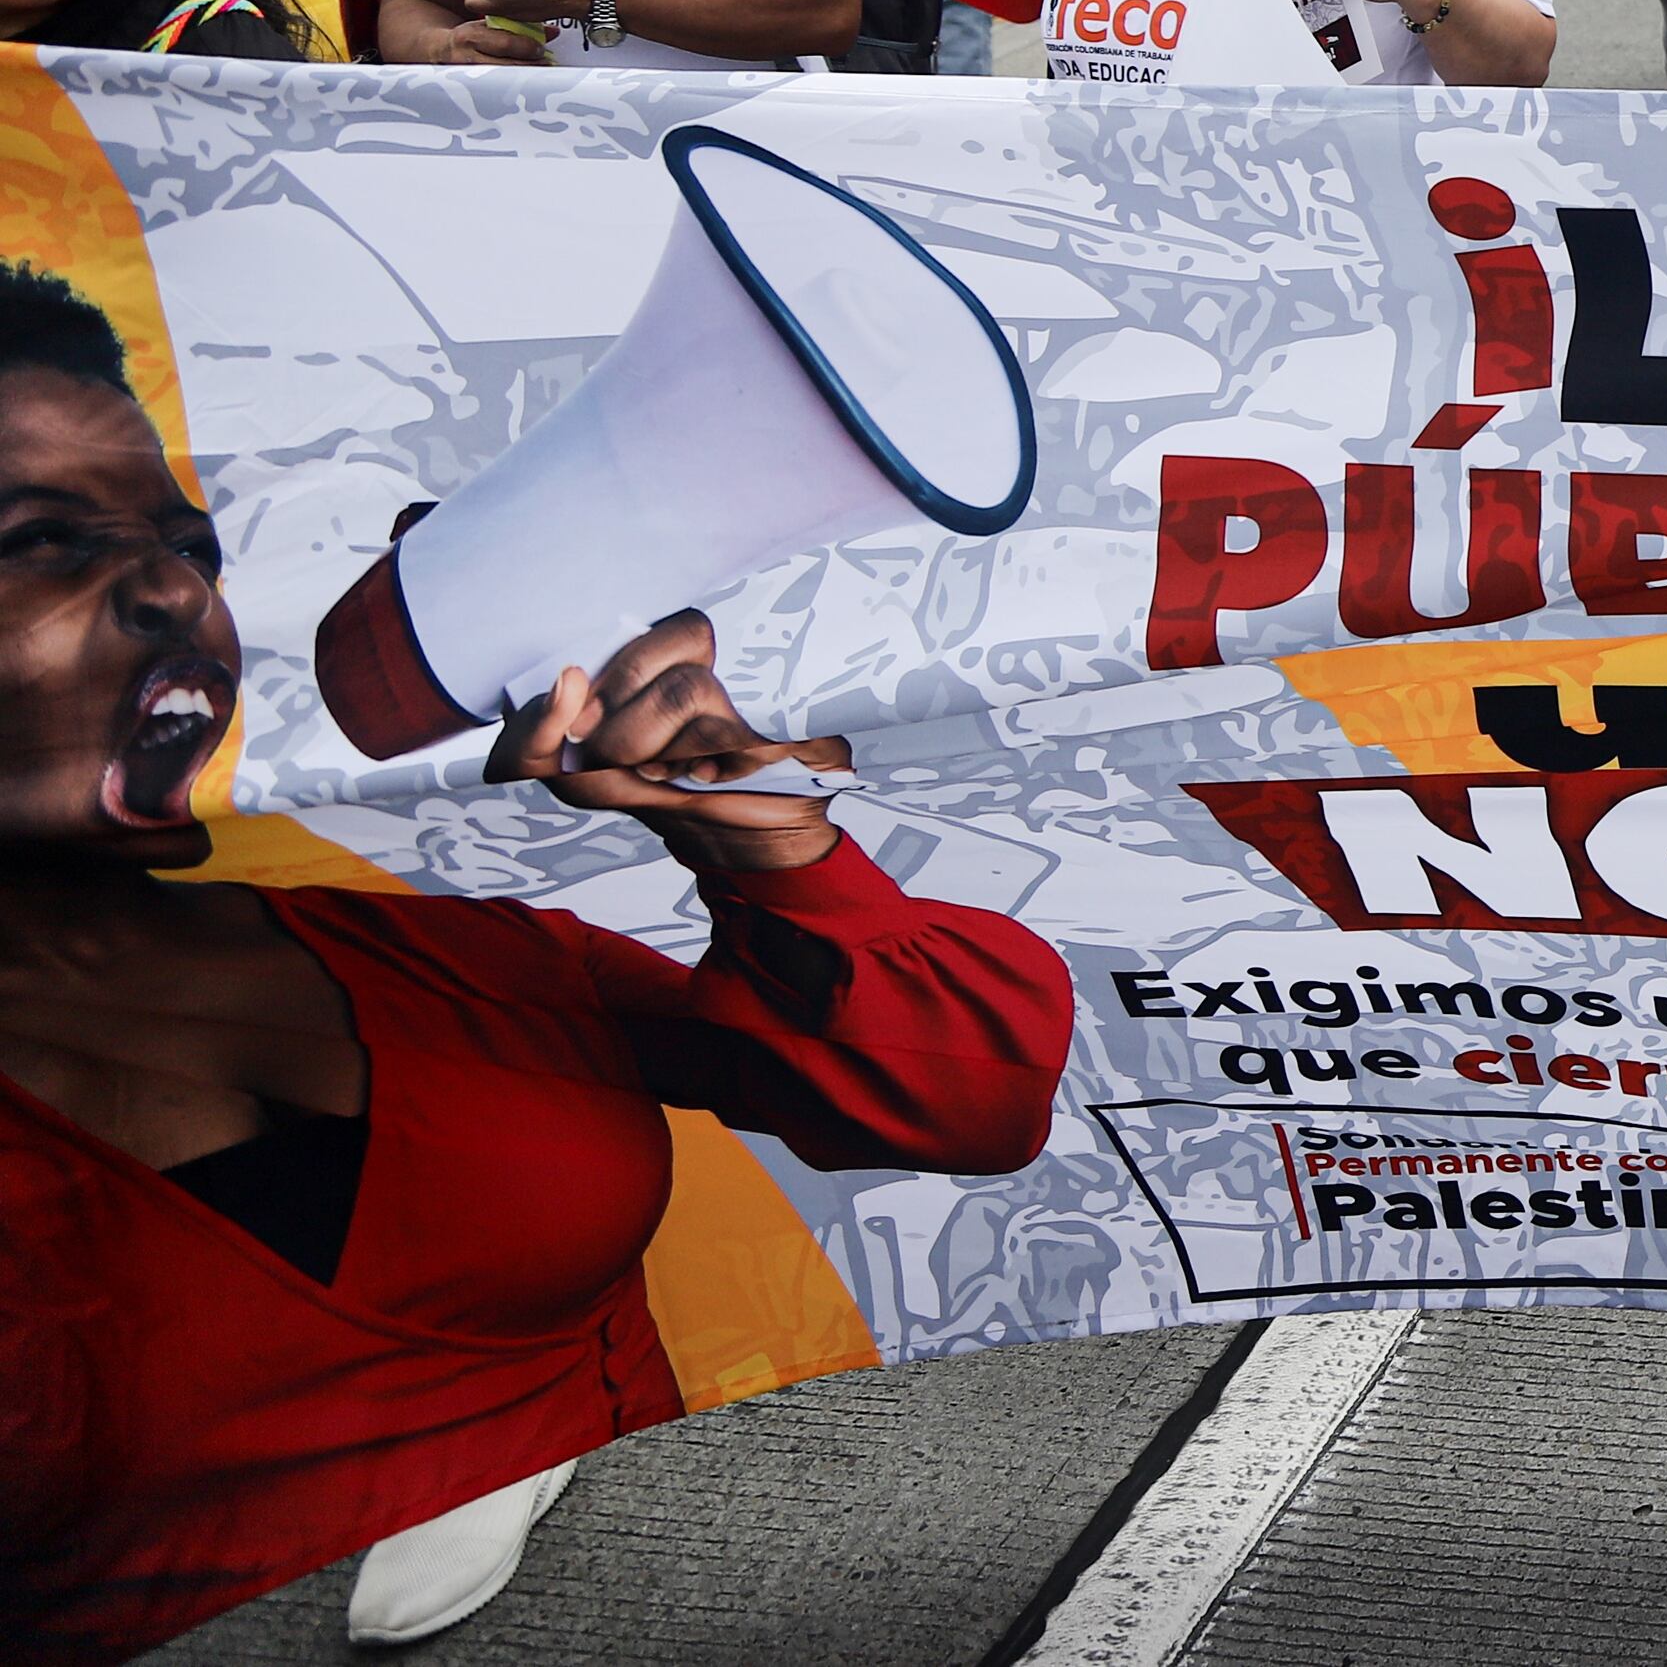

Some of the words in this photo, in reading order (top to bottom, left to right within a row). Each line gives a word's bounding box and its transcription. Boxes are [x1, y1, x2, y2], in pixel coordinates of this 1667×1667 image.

[1075, 45, 1123, 57] COLOMBIANA
[1125, 49, 1136, 59] DE
[1137, 50, 1174, 62] TRABAJA
[1088, 61, 1170, 84] EDUCAC
[1109, 965, 1623, 1031] Exigimos
[1218, 1037, 1421, 1096] que
[1305, 1150, 1603, 1178] Permanente
